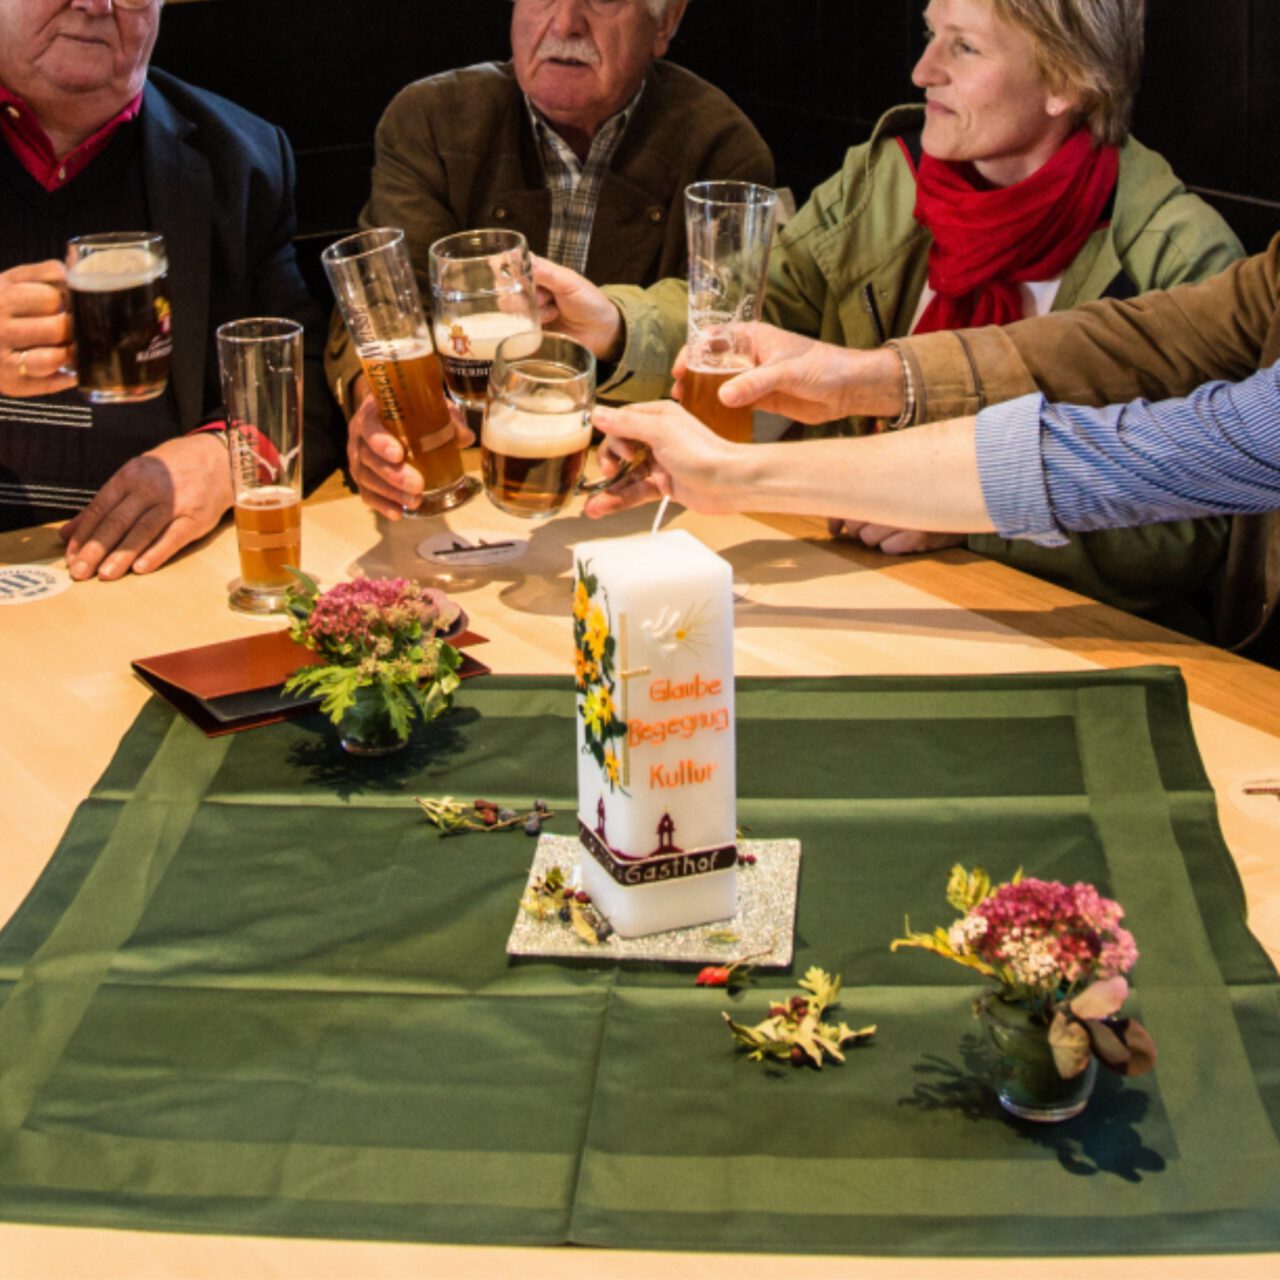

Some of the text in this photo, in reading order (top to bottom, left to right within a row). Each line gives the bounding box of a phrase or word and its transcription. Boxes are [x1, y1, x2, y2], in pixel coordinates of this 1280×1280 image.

[649, 674, 722, 702] Glaube
[649, 761, 717, 789] Kultur
[624, 851, 720, 883] Gasthof
